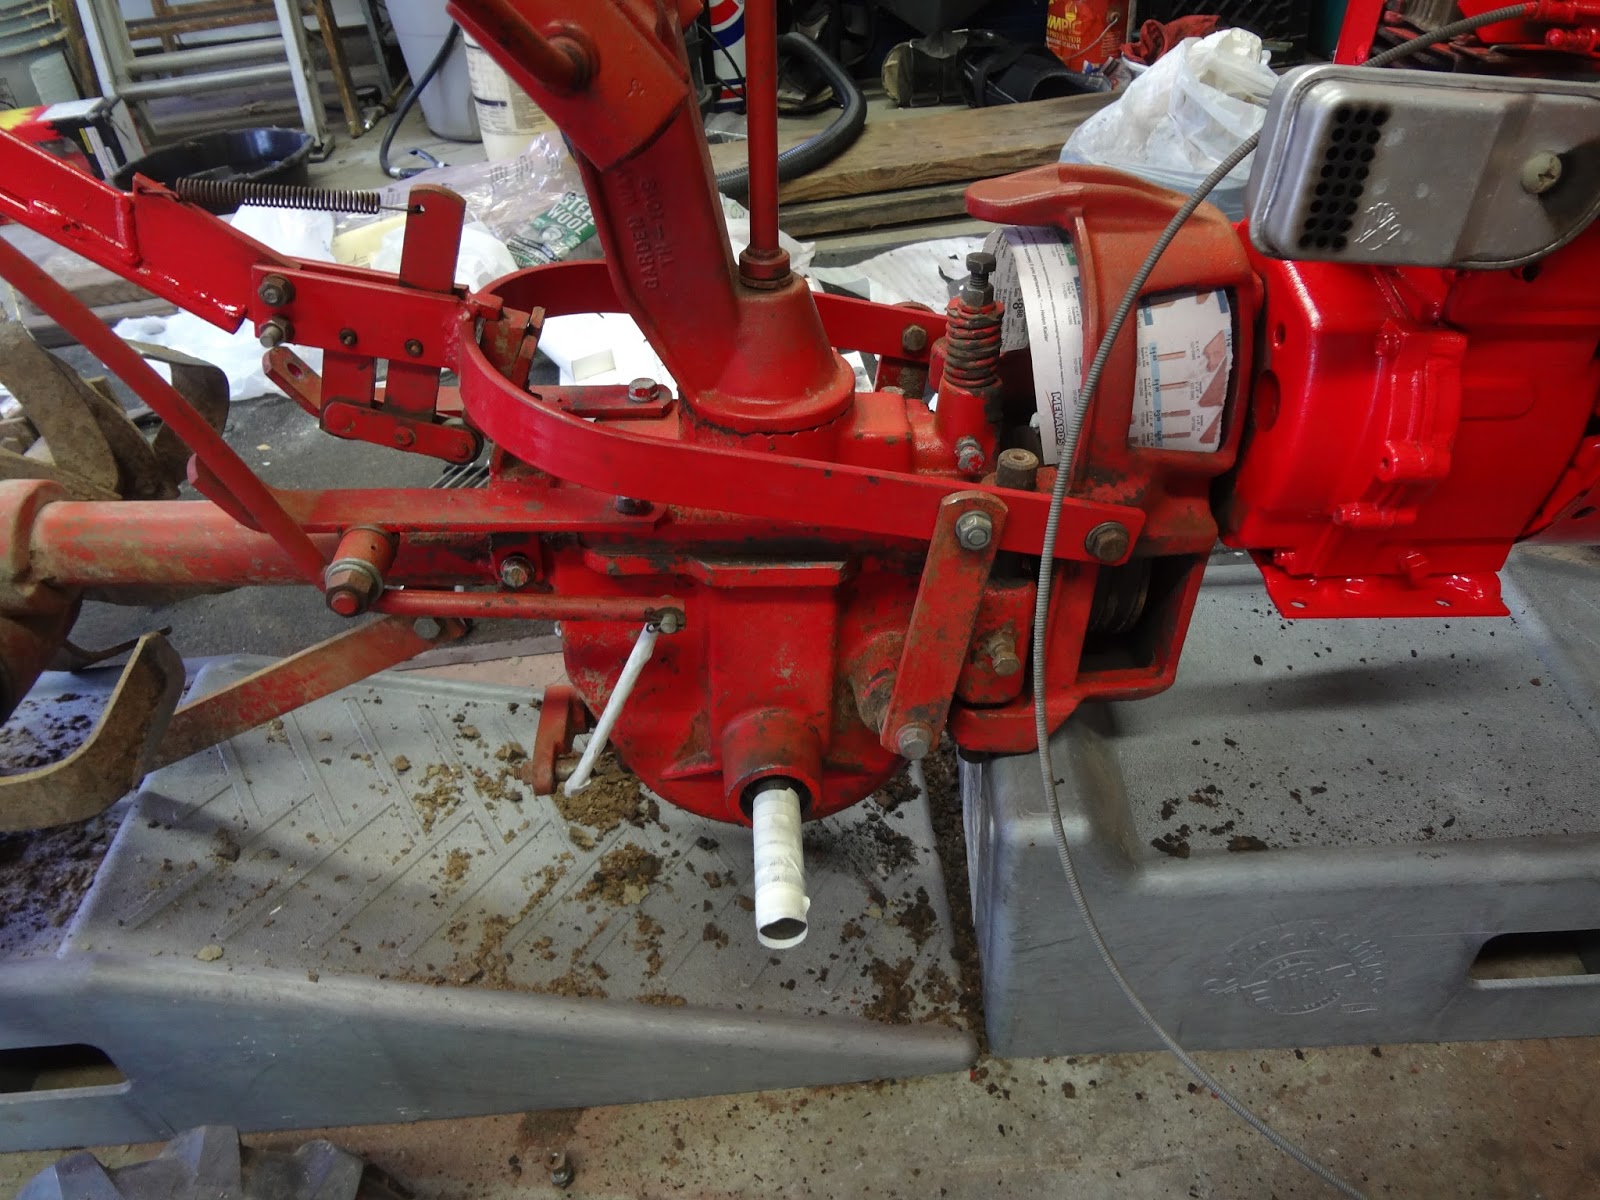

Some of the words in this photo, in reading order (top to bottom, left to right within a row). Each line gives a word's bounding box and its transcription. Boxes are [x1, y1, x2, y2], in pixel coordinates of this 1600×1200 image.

[547, 204, 588, 235] WOOL
[626, 214, 660, 289] GARDEN
[1051, 391, 1066, 447] MENARDS
